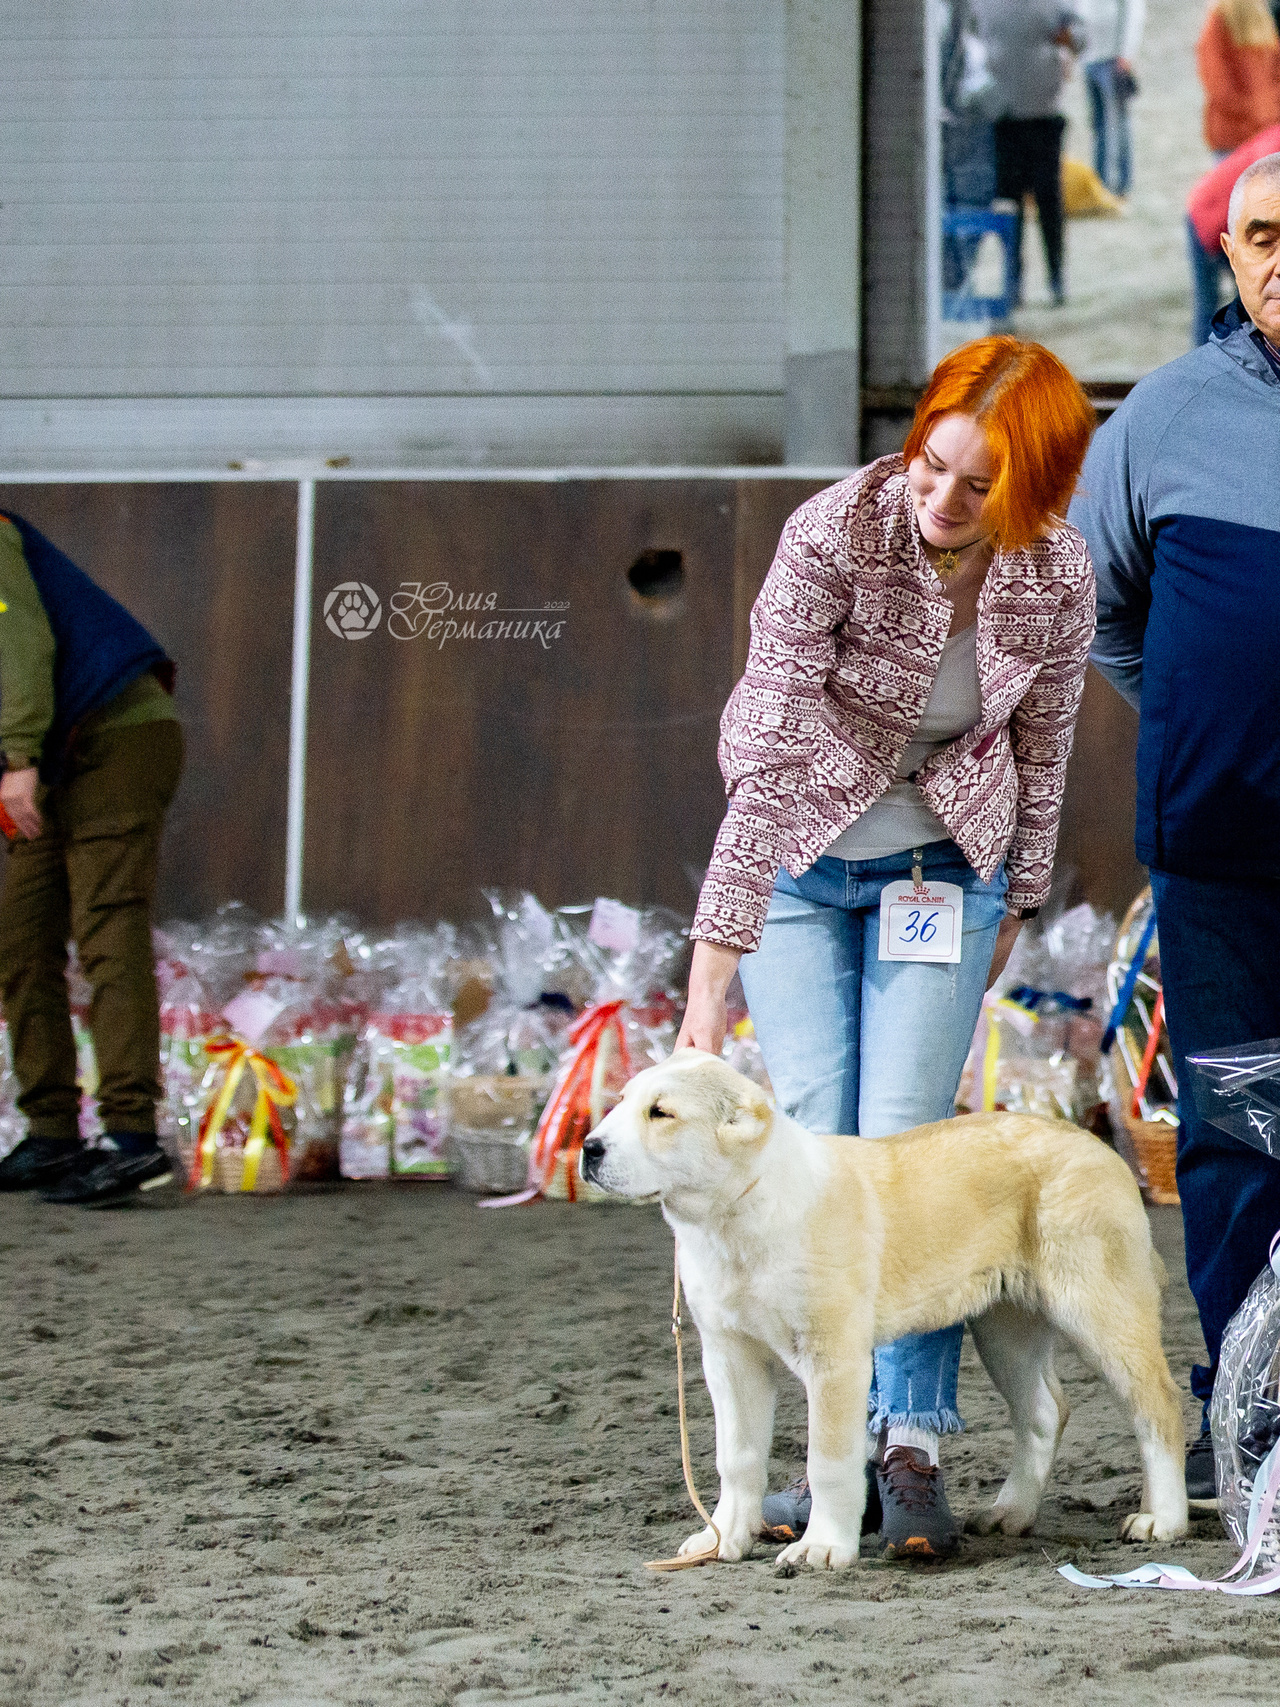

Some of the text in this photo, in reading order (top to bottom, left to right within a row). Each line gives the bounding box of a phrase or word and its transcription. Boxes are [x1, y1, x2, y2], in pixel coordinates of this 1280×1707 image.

[897, 895, 945, 904] ROYAL CANIN
[899, 910, 939, 943] 36
